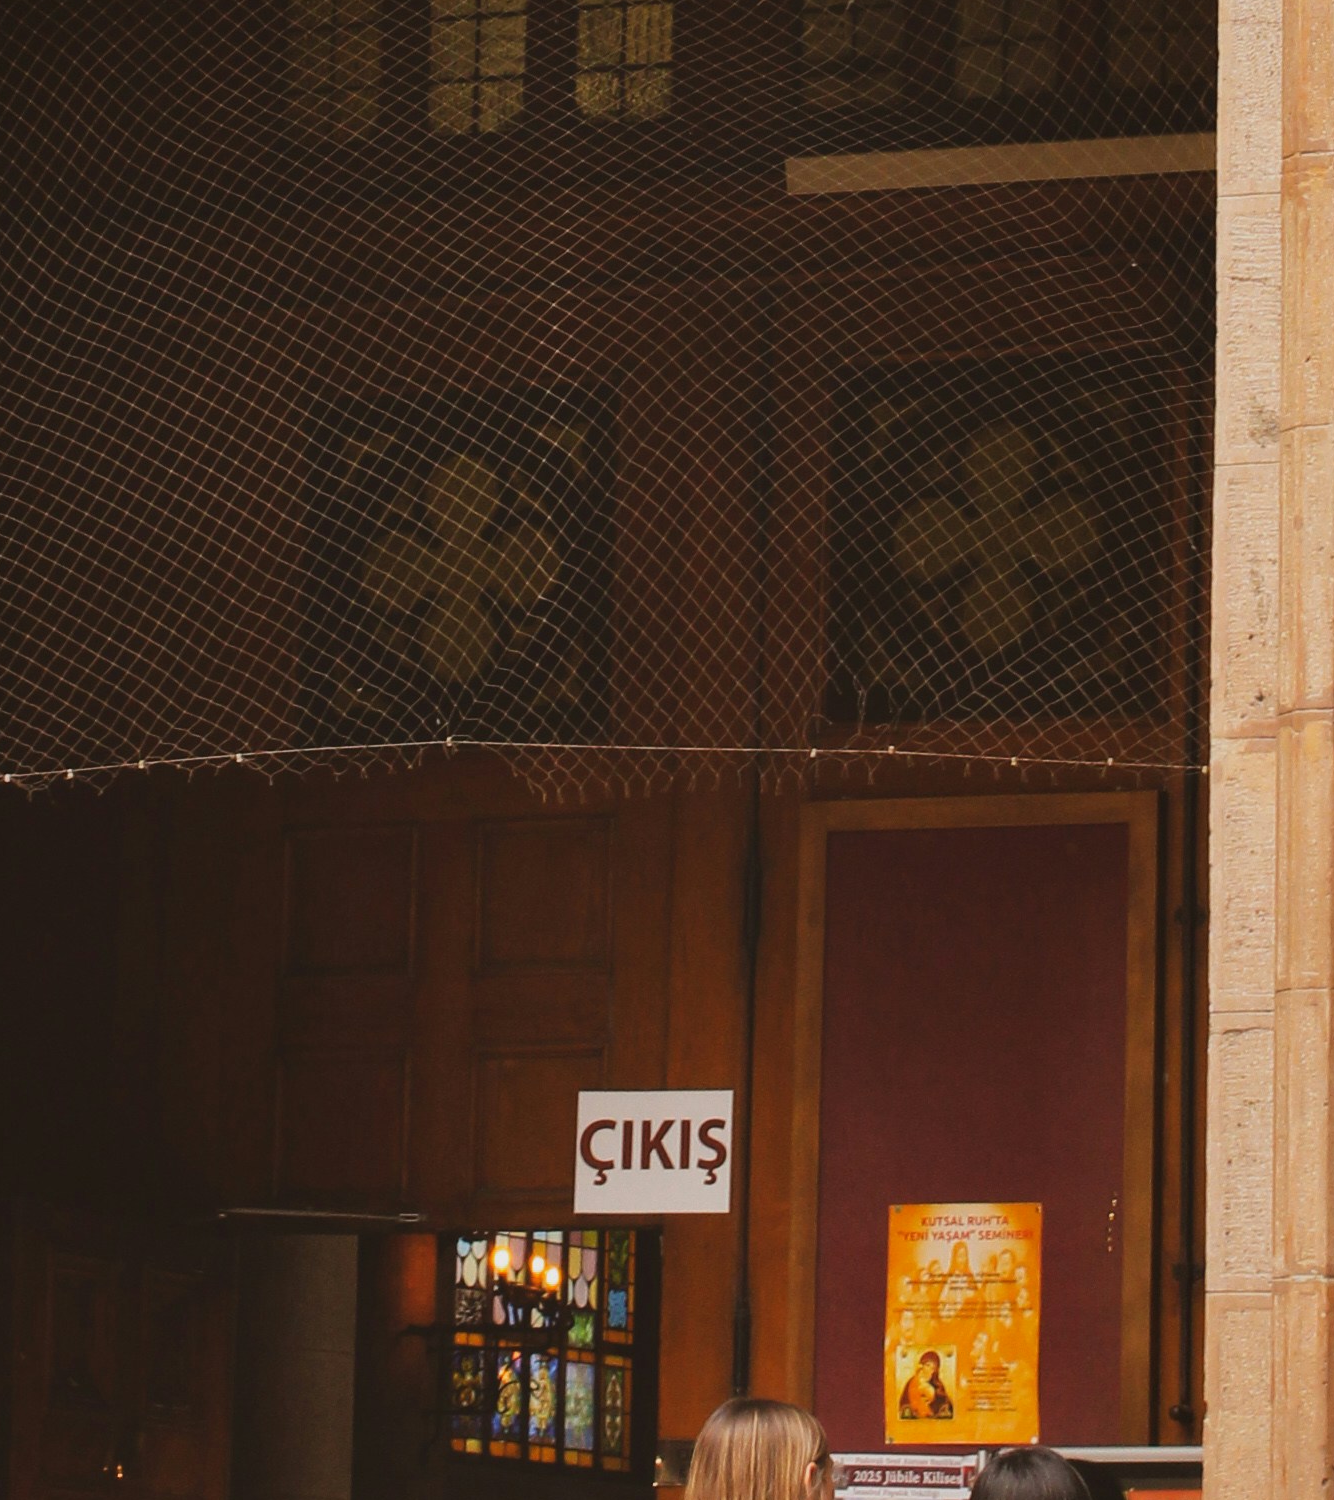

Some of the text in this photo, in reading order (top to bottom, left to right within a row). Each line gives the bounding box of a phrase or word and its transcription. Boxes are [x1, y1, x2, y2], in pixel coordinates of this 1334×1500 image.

[580, 1118, 727, 1186] ÇIKIŞ
[920, 1215, 1009, 1227] KUTSAL RUH'TA
[931, 1229, 975, 1243] YAŞAM"
[853, 1470, 882, 1483] 2025
[882, 1470, 921, 1485] Jübile
